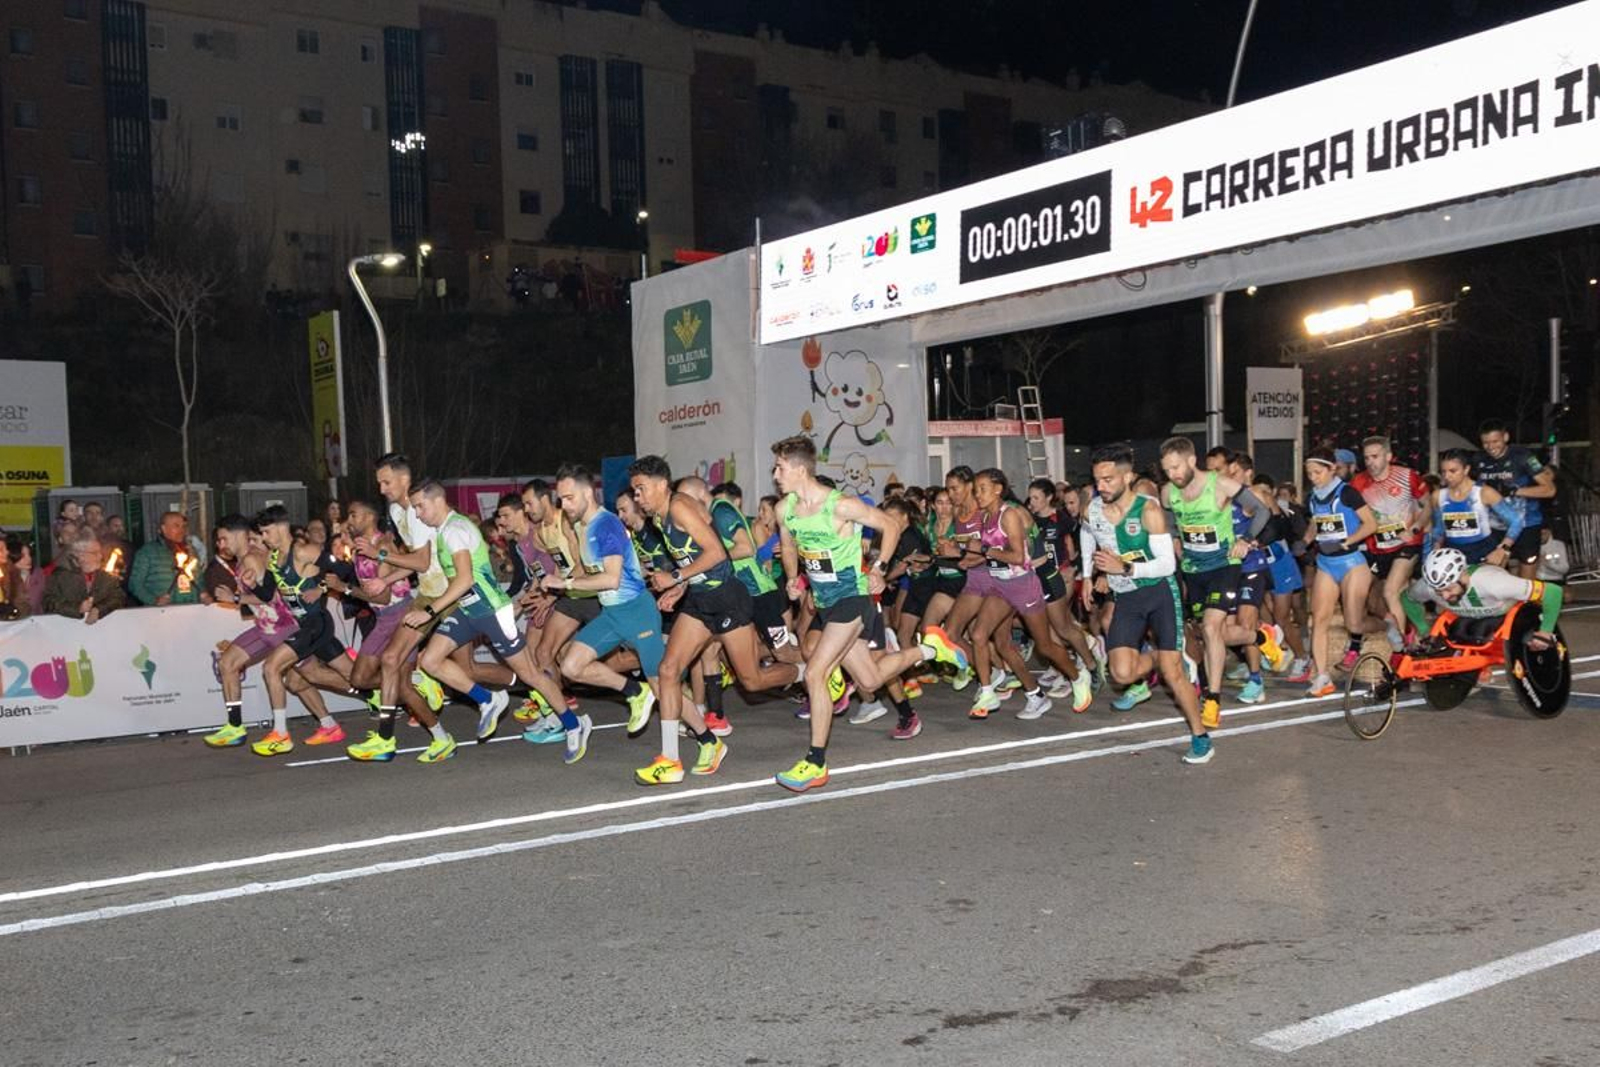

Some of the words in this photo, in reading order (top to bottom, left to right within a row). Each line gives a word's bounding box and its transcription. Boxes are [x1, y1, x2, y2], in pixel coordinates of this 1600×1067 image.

[1130, 176, 1173, 228] 42
[1182, 129, 1354, 219] CARRERA
[1367, 79, 1540, 172] URBANA
[968, 195, 1101, 263] 00:00:01.30
[1252, 388, 1300, 404] ATENCIÓN
[659, 400, 721, 424] calderón
[1258, 406, 1295, 418] MEDIOS
[6, 470, 50, 481] OSUNA
[1321, 522, 1335, 531] 46
[1452, 519, 1468, 528] 45
[1190, 532, 1206, 542] 54
[805, 559, 821, 571] 58
[0, 704, 32, 717] Jaén
